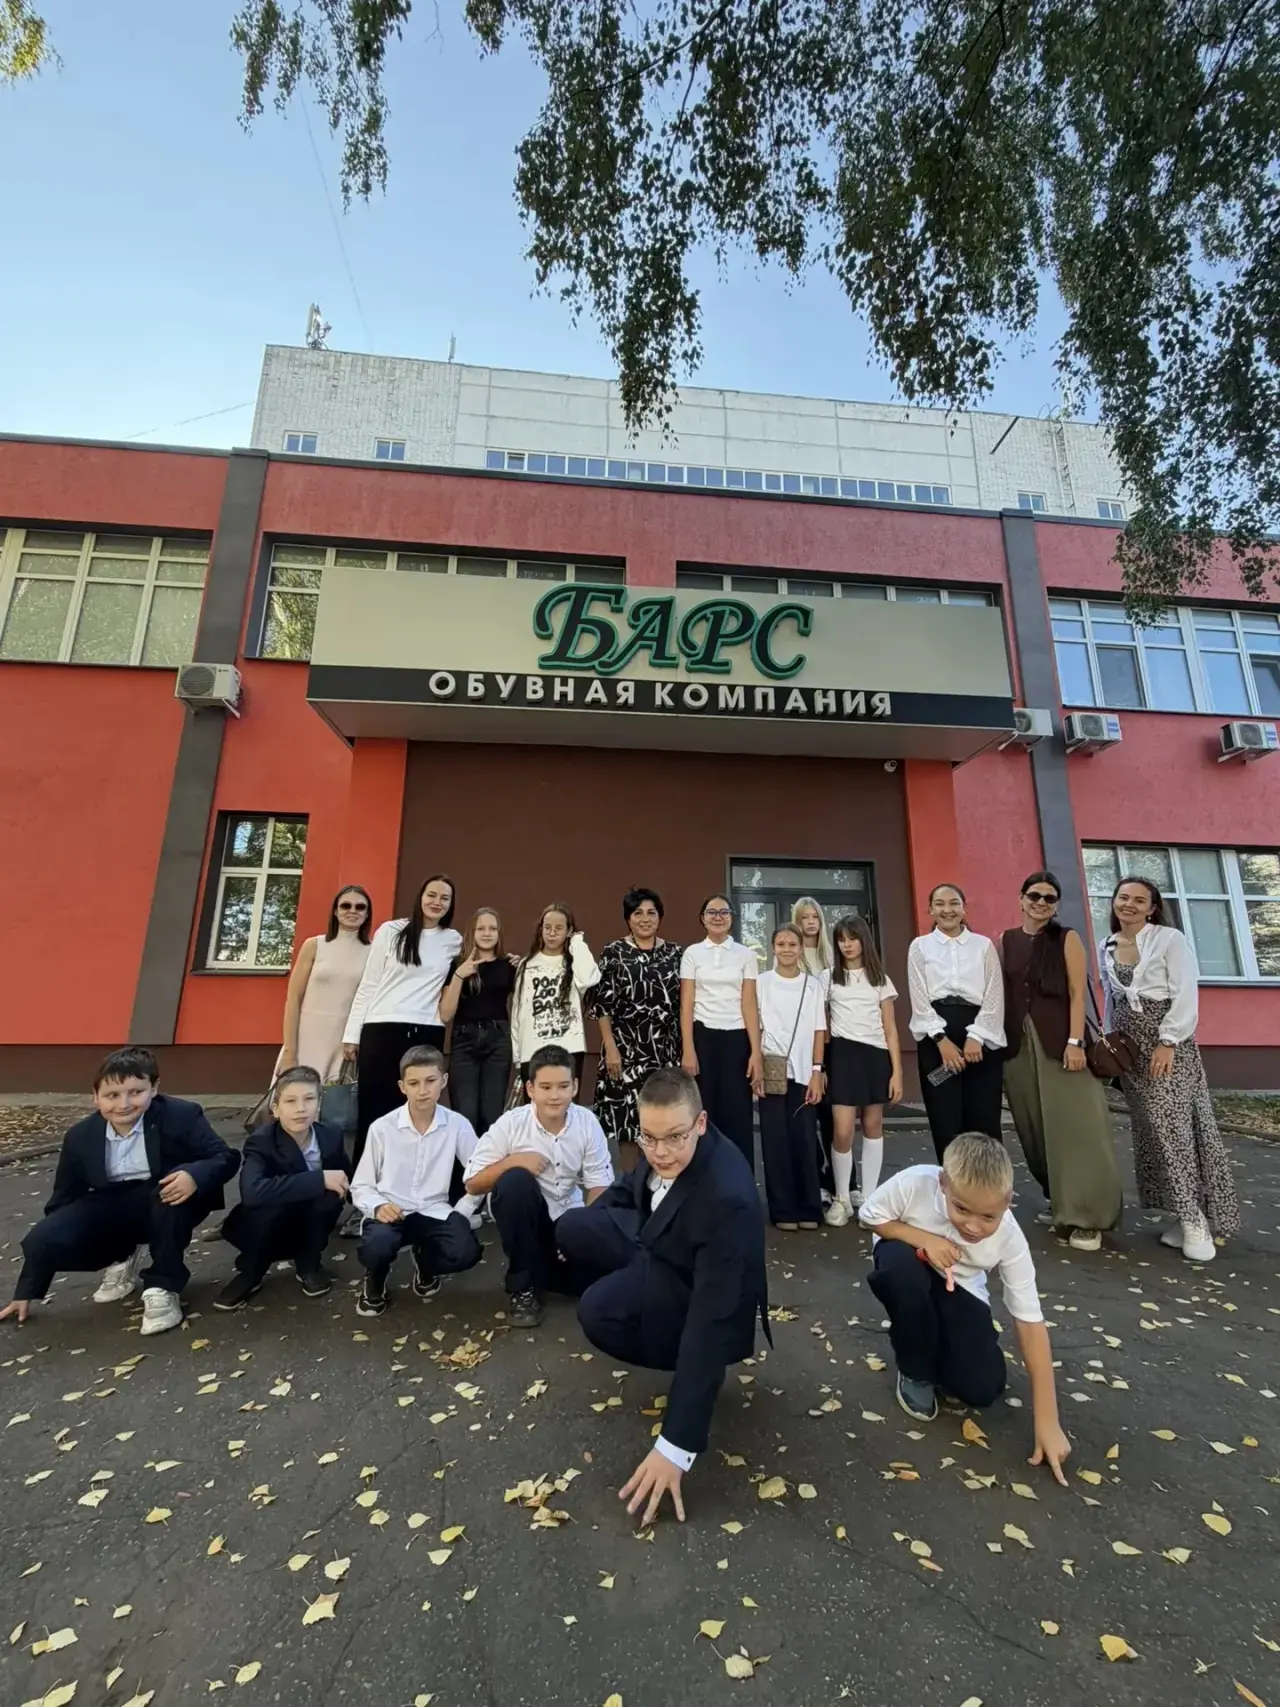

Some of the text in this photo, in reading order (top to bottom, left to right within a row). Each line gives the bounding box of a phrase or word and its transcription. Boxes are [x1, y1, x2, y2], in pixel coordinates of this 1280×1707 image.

[534, 582, 814, 679] БАРС
[428, 670, 893, 718] ОБУВНАЯ КОМПАНИЯ
